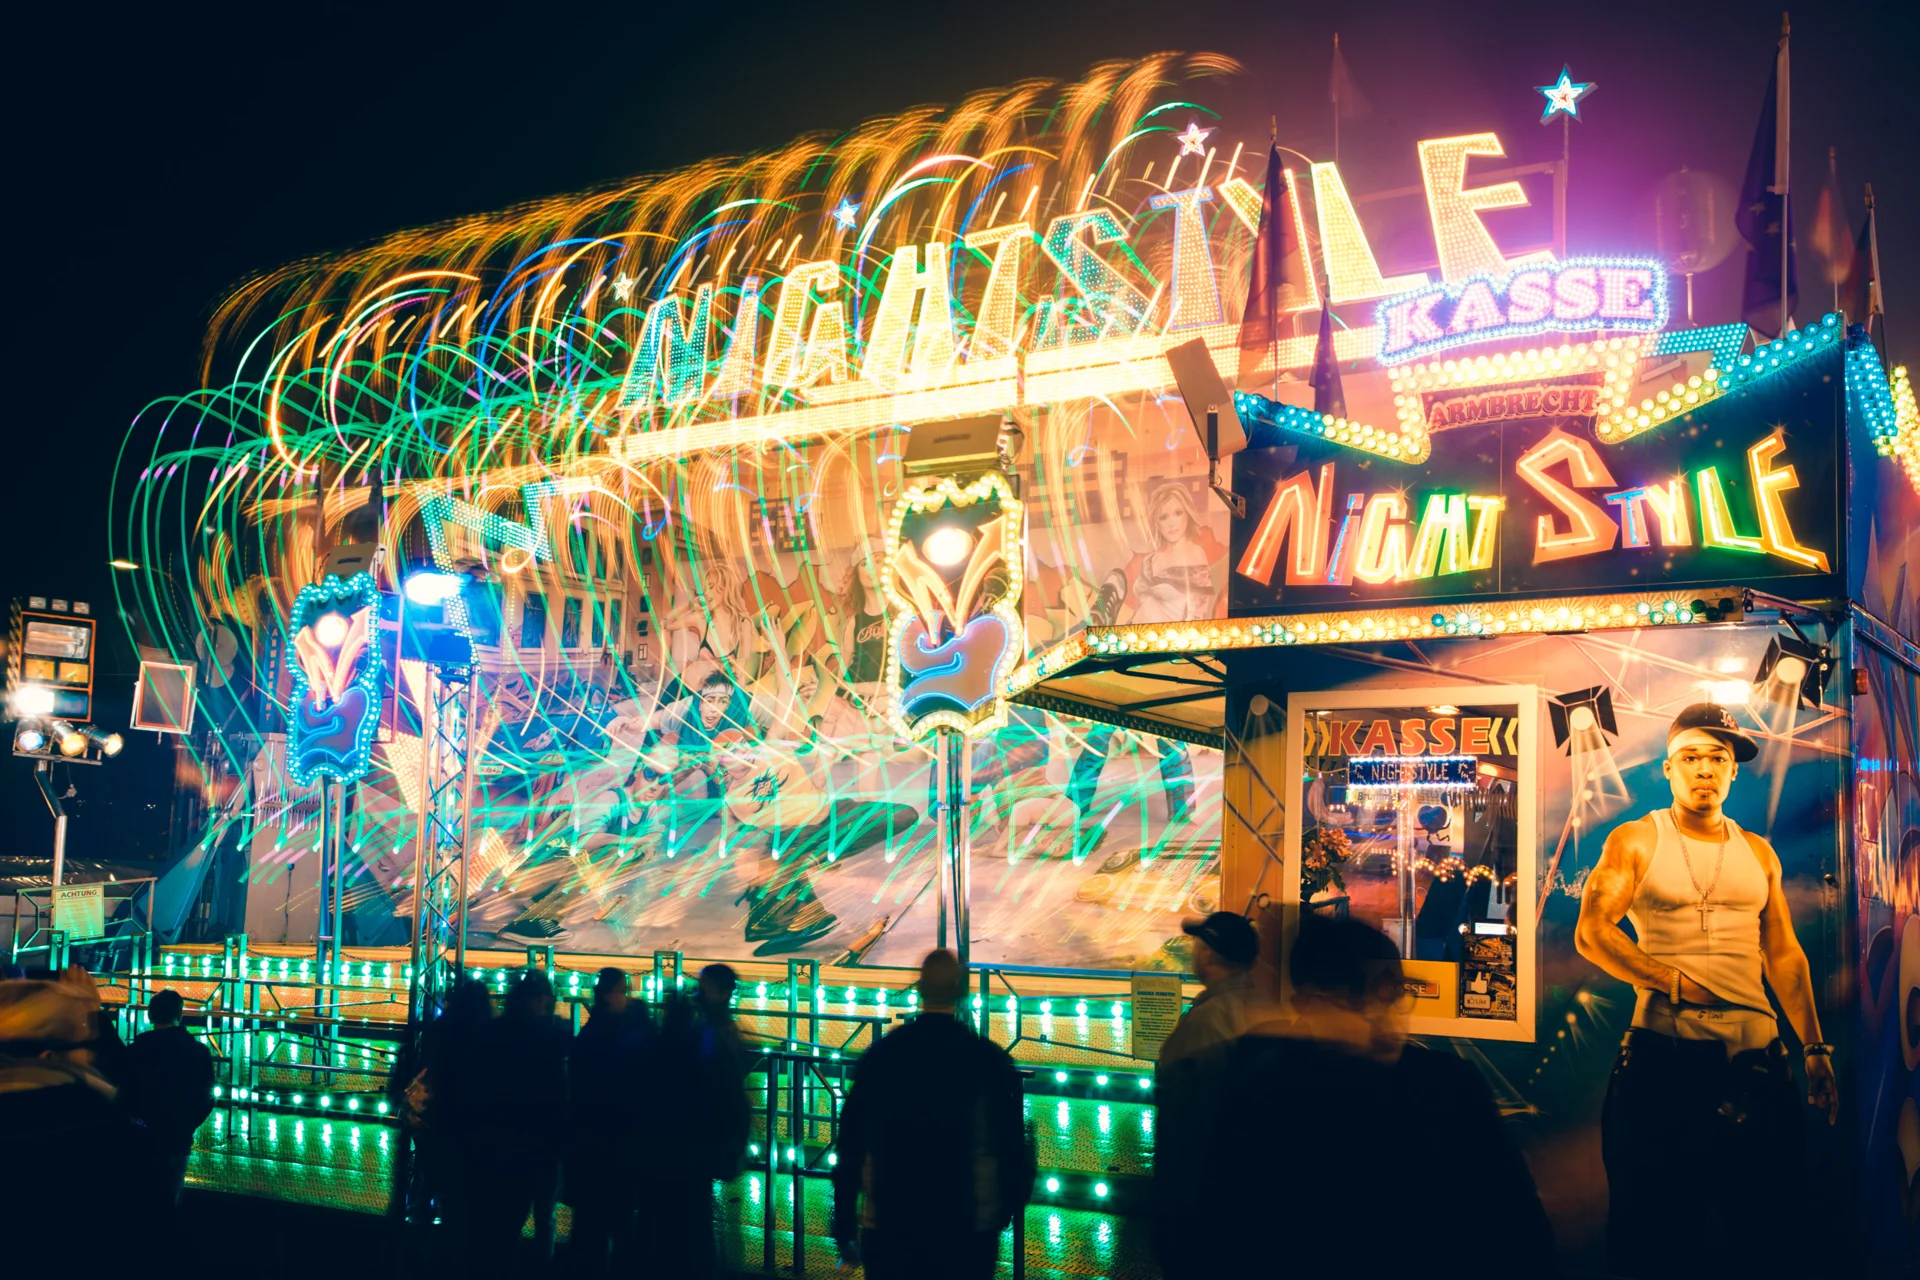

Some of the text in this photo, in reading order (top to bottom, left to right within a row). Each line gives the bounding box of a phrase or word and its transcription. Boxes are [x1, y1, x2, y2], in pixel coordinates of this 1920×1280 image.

[1384, 266, 1655, 354] KASSE
[1428, 388, 1602, 432] ARMBRECHT
[1327, 717, 1492, 756] KASSE
[61, 889, 97, 898] ACHTUNG
